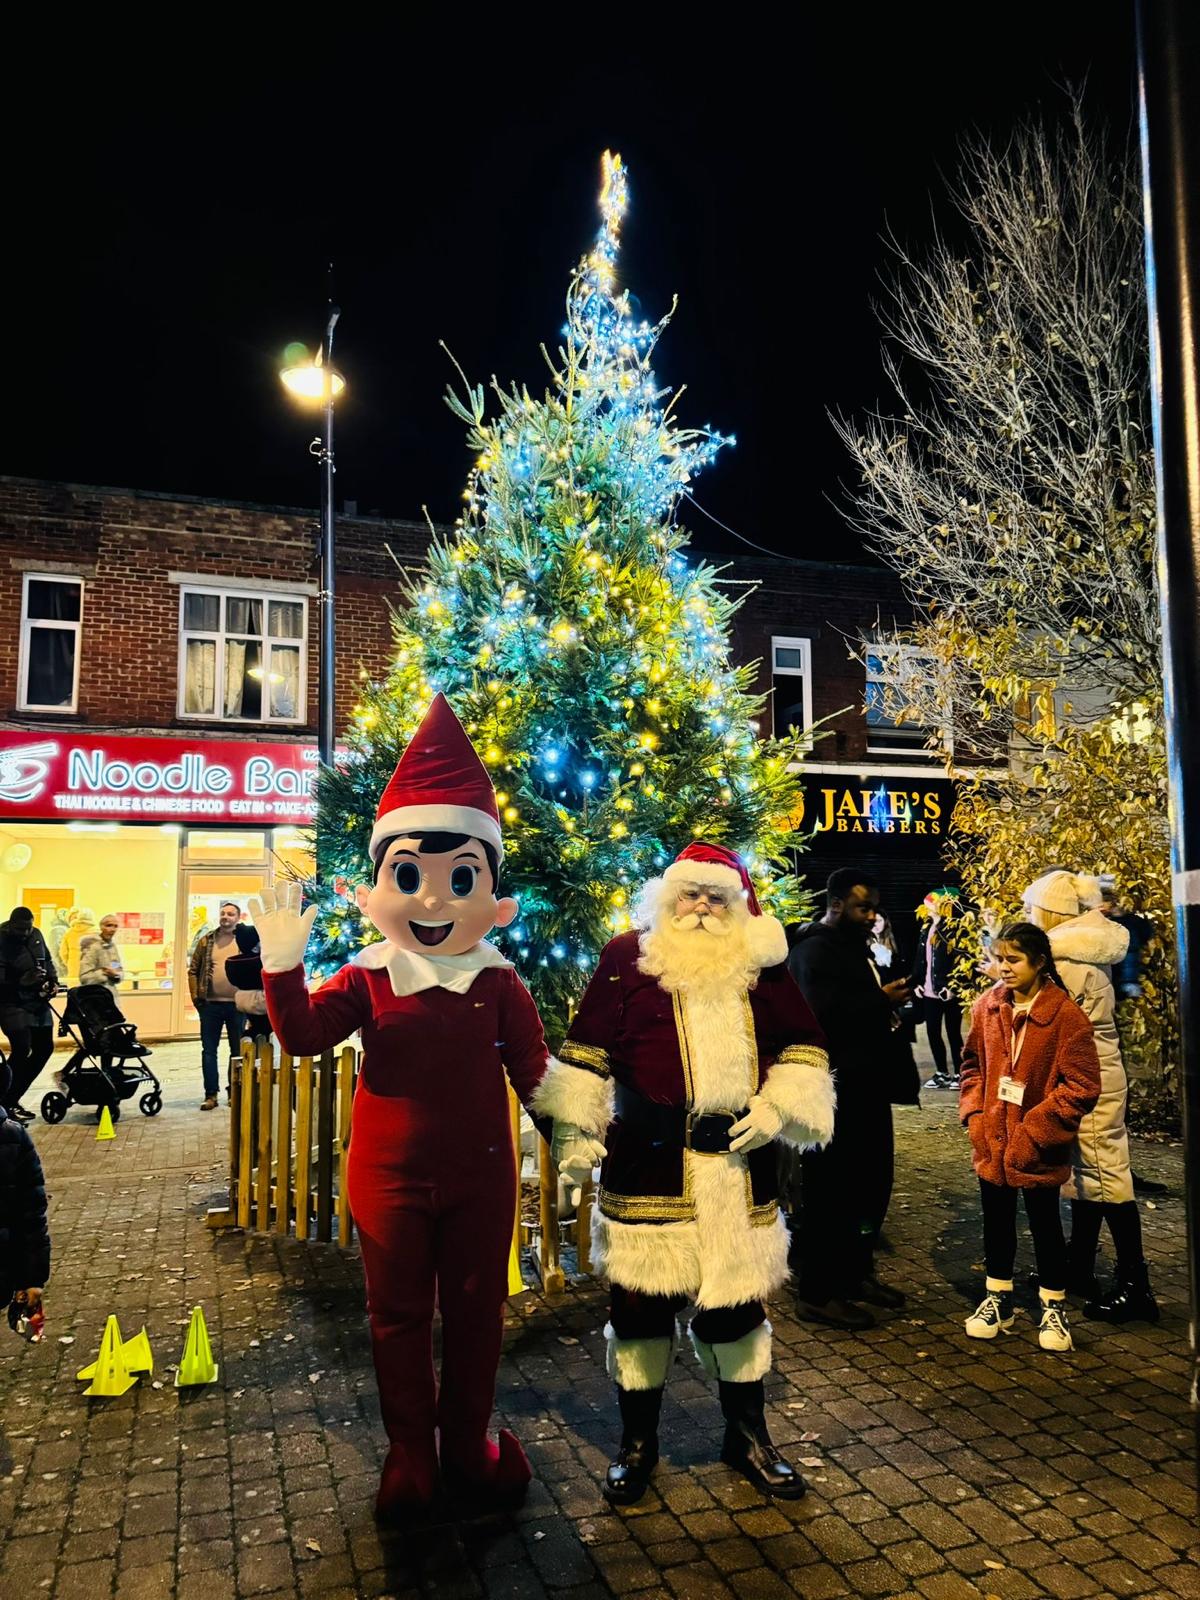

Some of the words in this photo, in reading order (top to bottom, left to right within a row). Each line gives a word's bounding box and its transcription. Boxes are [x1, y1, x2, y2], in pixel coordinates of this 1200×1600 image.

[68, 748, 232, 793] Noodle
[244, 756, 318, 796] Bar
[53, 794, 83, 809] THAI
[84, 795, 132, 811] NOODLE
[132, 797, 142, 812] &
[142, 797, 191, 813] CHINESE
[191, 798, 225, 813] FOOD
[229, 799, 252, 814] EAT
[252, 800, 265, 814] IN
[837, 818, 940, 834] BARBERS
